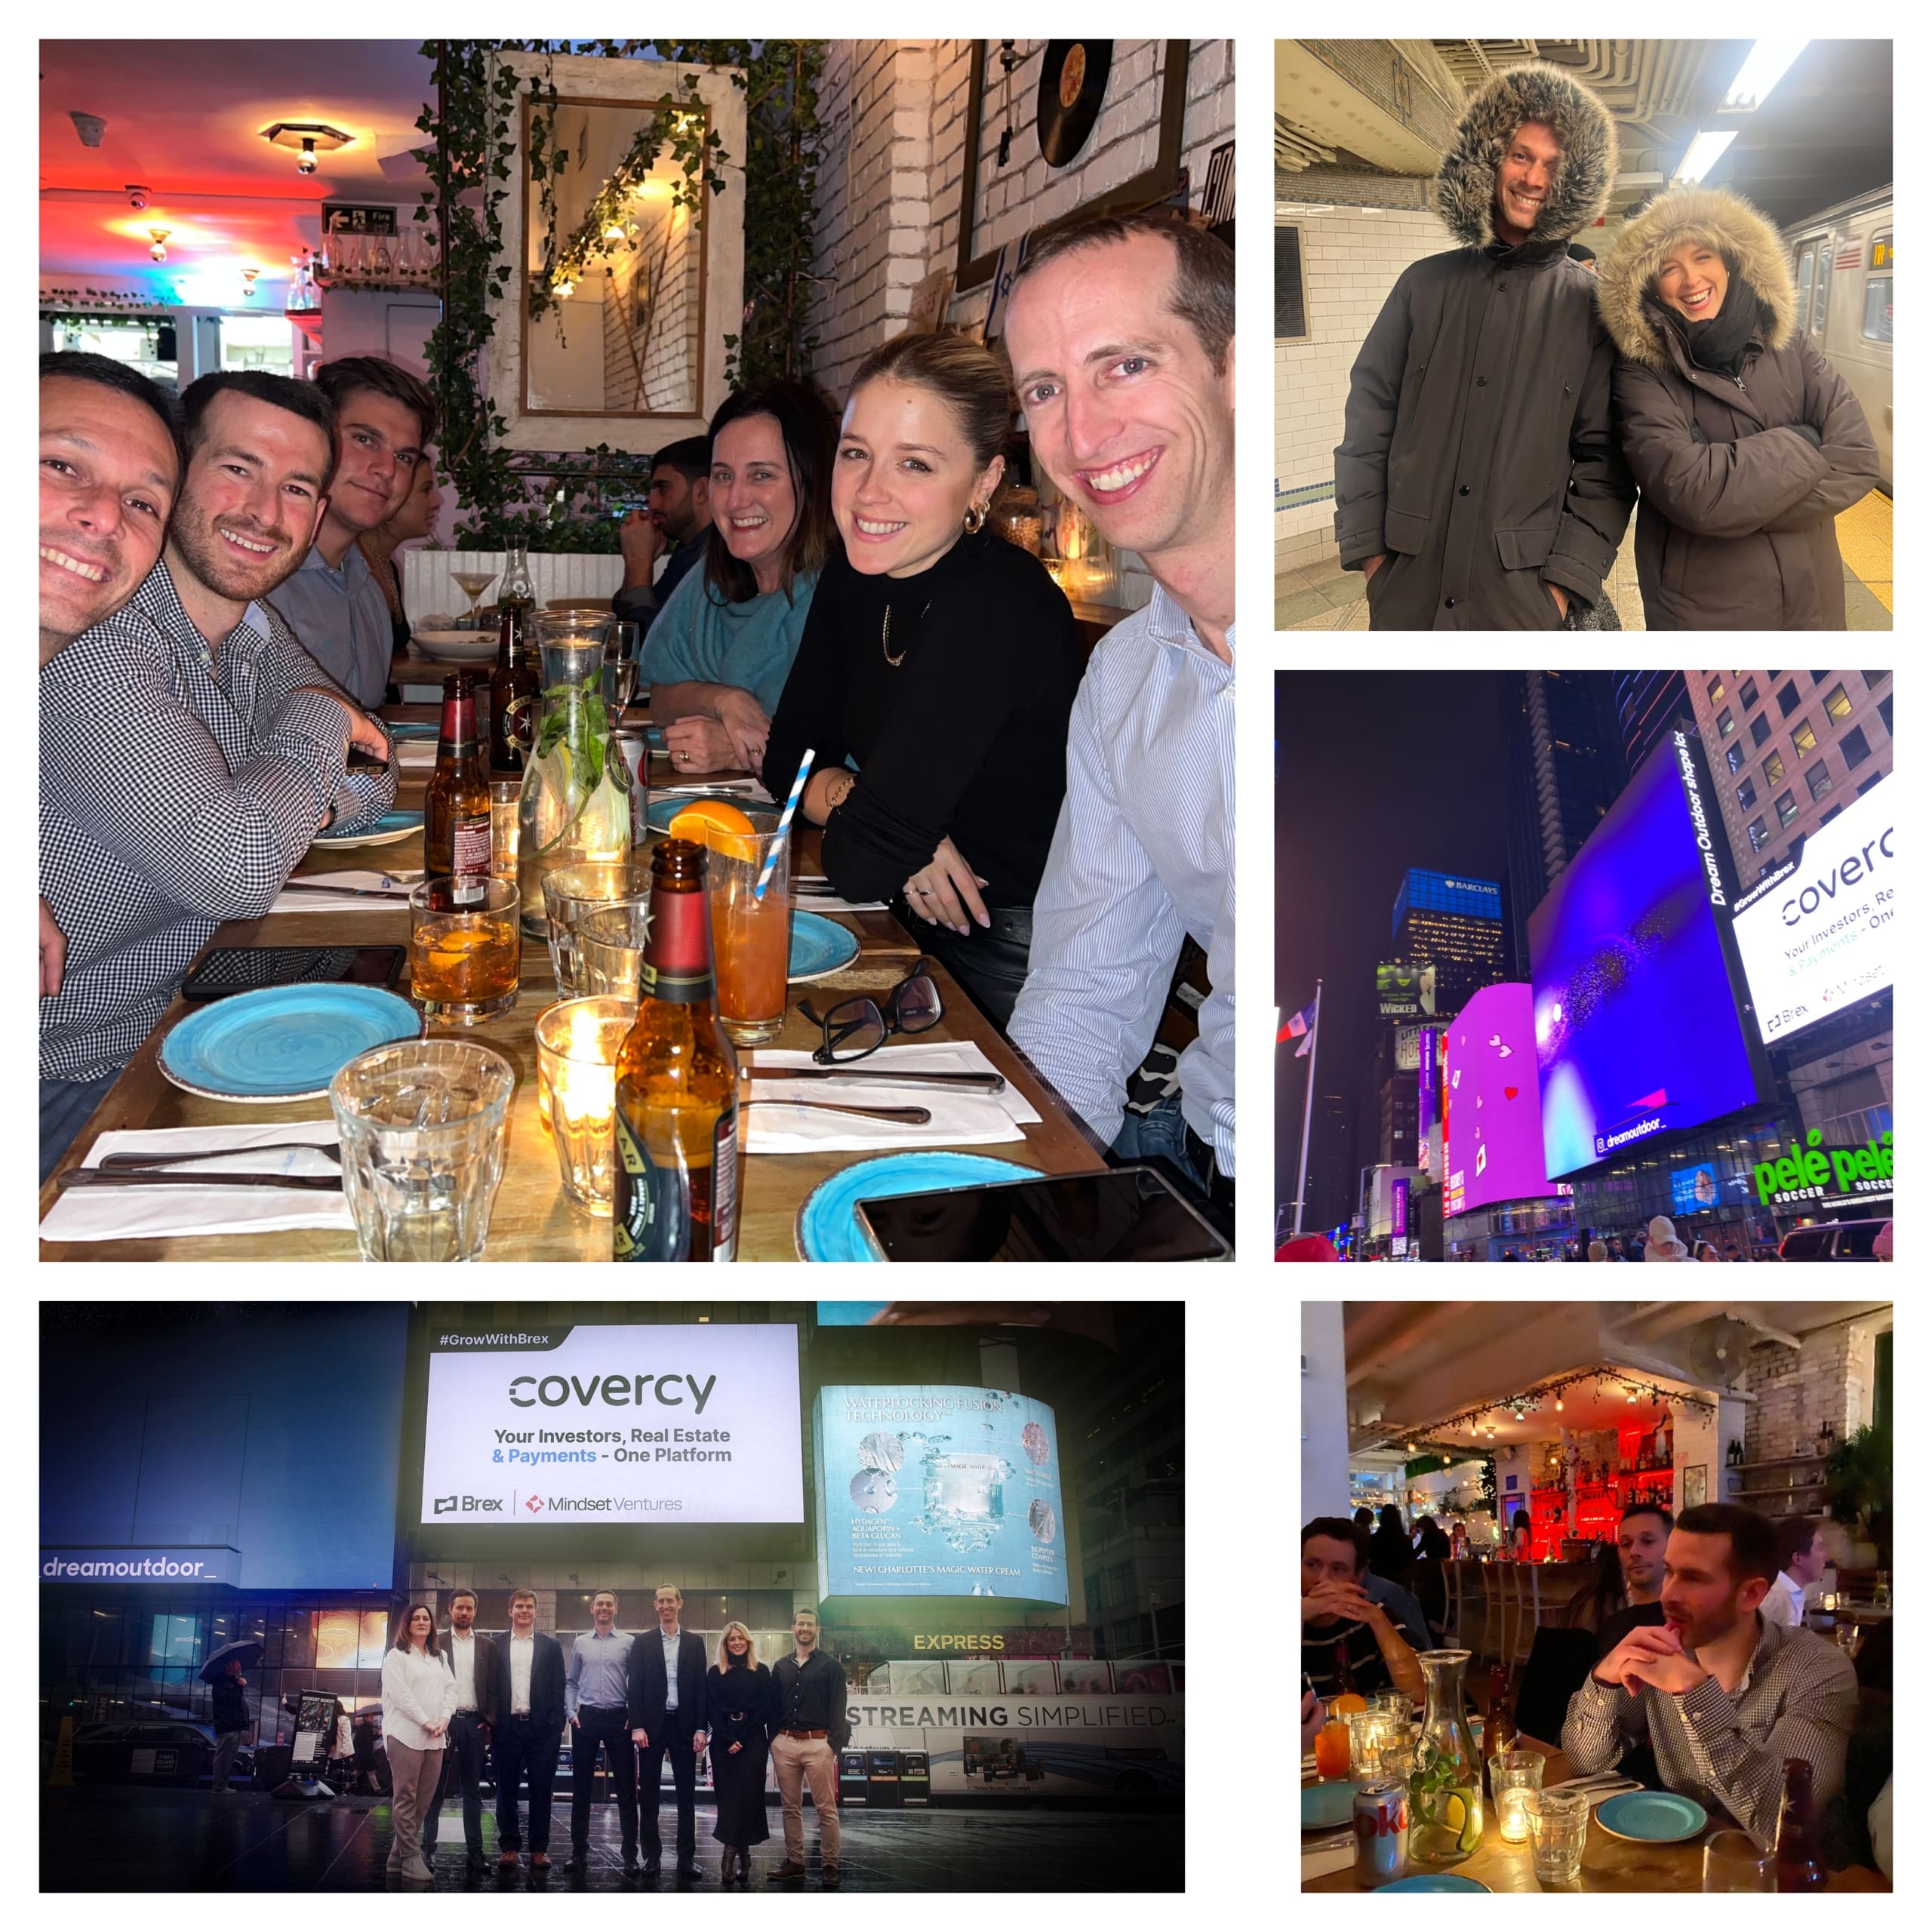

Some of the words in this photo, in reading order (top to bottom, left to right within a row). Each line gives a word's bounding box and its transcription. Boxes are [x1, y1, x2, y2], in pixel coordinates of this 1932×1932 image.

[1679, 748, 1697, 789] shape
[1689, 789, 1712, 851] Outdoor
[1704, 852, 1726, 906] Dream
[1734, 861, 1795, 912] #GrowWithBrex
[1782, 826, 1894, 926] coverc
[1456, 881, 1498, 895] BARCLAYS
[1784, 940, 1810, 961] Your
[1875, 888, 1894, 906] Re
[1782, 1003, 1809, 1023] Brex
[1753, 1128, 1831, 1206] pelé
[1775, 1186, 1825, 1203] SOCCER
[1855, 1180, 1893, 1191] SOCCE
[439, 1334, 549, 1346] #GrowWithBrex
[509, 1374, 716, 1414] covercy
[844, 1397, 954, 1409] WATERLOCKING
[956, 1398, 1003, 1413] FUSION
[494, 1429, 535, 1444] Your
[539, 1429, 626, 1446] Investors,
[631, 1428, 668, 1442] Real
[673, 1428, 731, 1442] Estate
[492, 1449, 504, 1463] &
[509, 1448, 597, 1466] Payments
[614, 1447, 651, 1463] One
[655, 1447, 732, 1463] Platform
[462, 1495, 503, 1512] Brex
[549, 1497, 612, 1511] Mindset
[613, 1497, 682, 1511] Ventures
[39, 1557, 217, 1578] dreamoutdoor_
[878, 1565, 935, 1574] CHARLOTTE'S
[968, 1566, 994, 1574] WATER
[995, 1567, 1021, 1576] CREAM
[914, 1635, 1004, 1650] EXPRESS
[847, 1706, 1008, 1727] STREAMING
